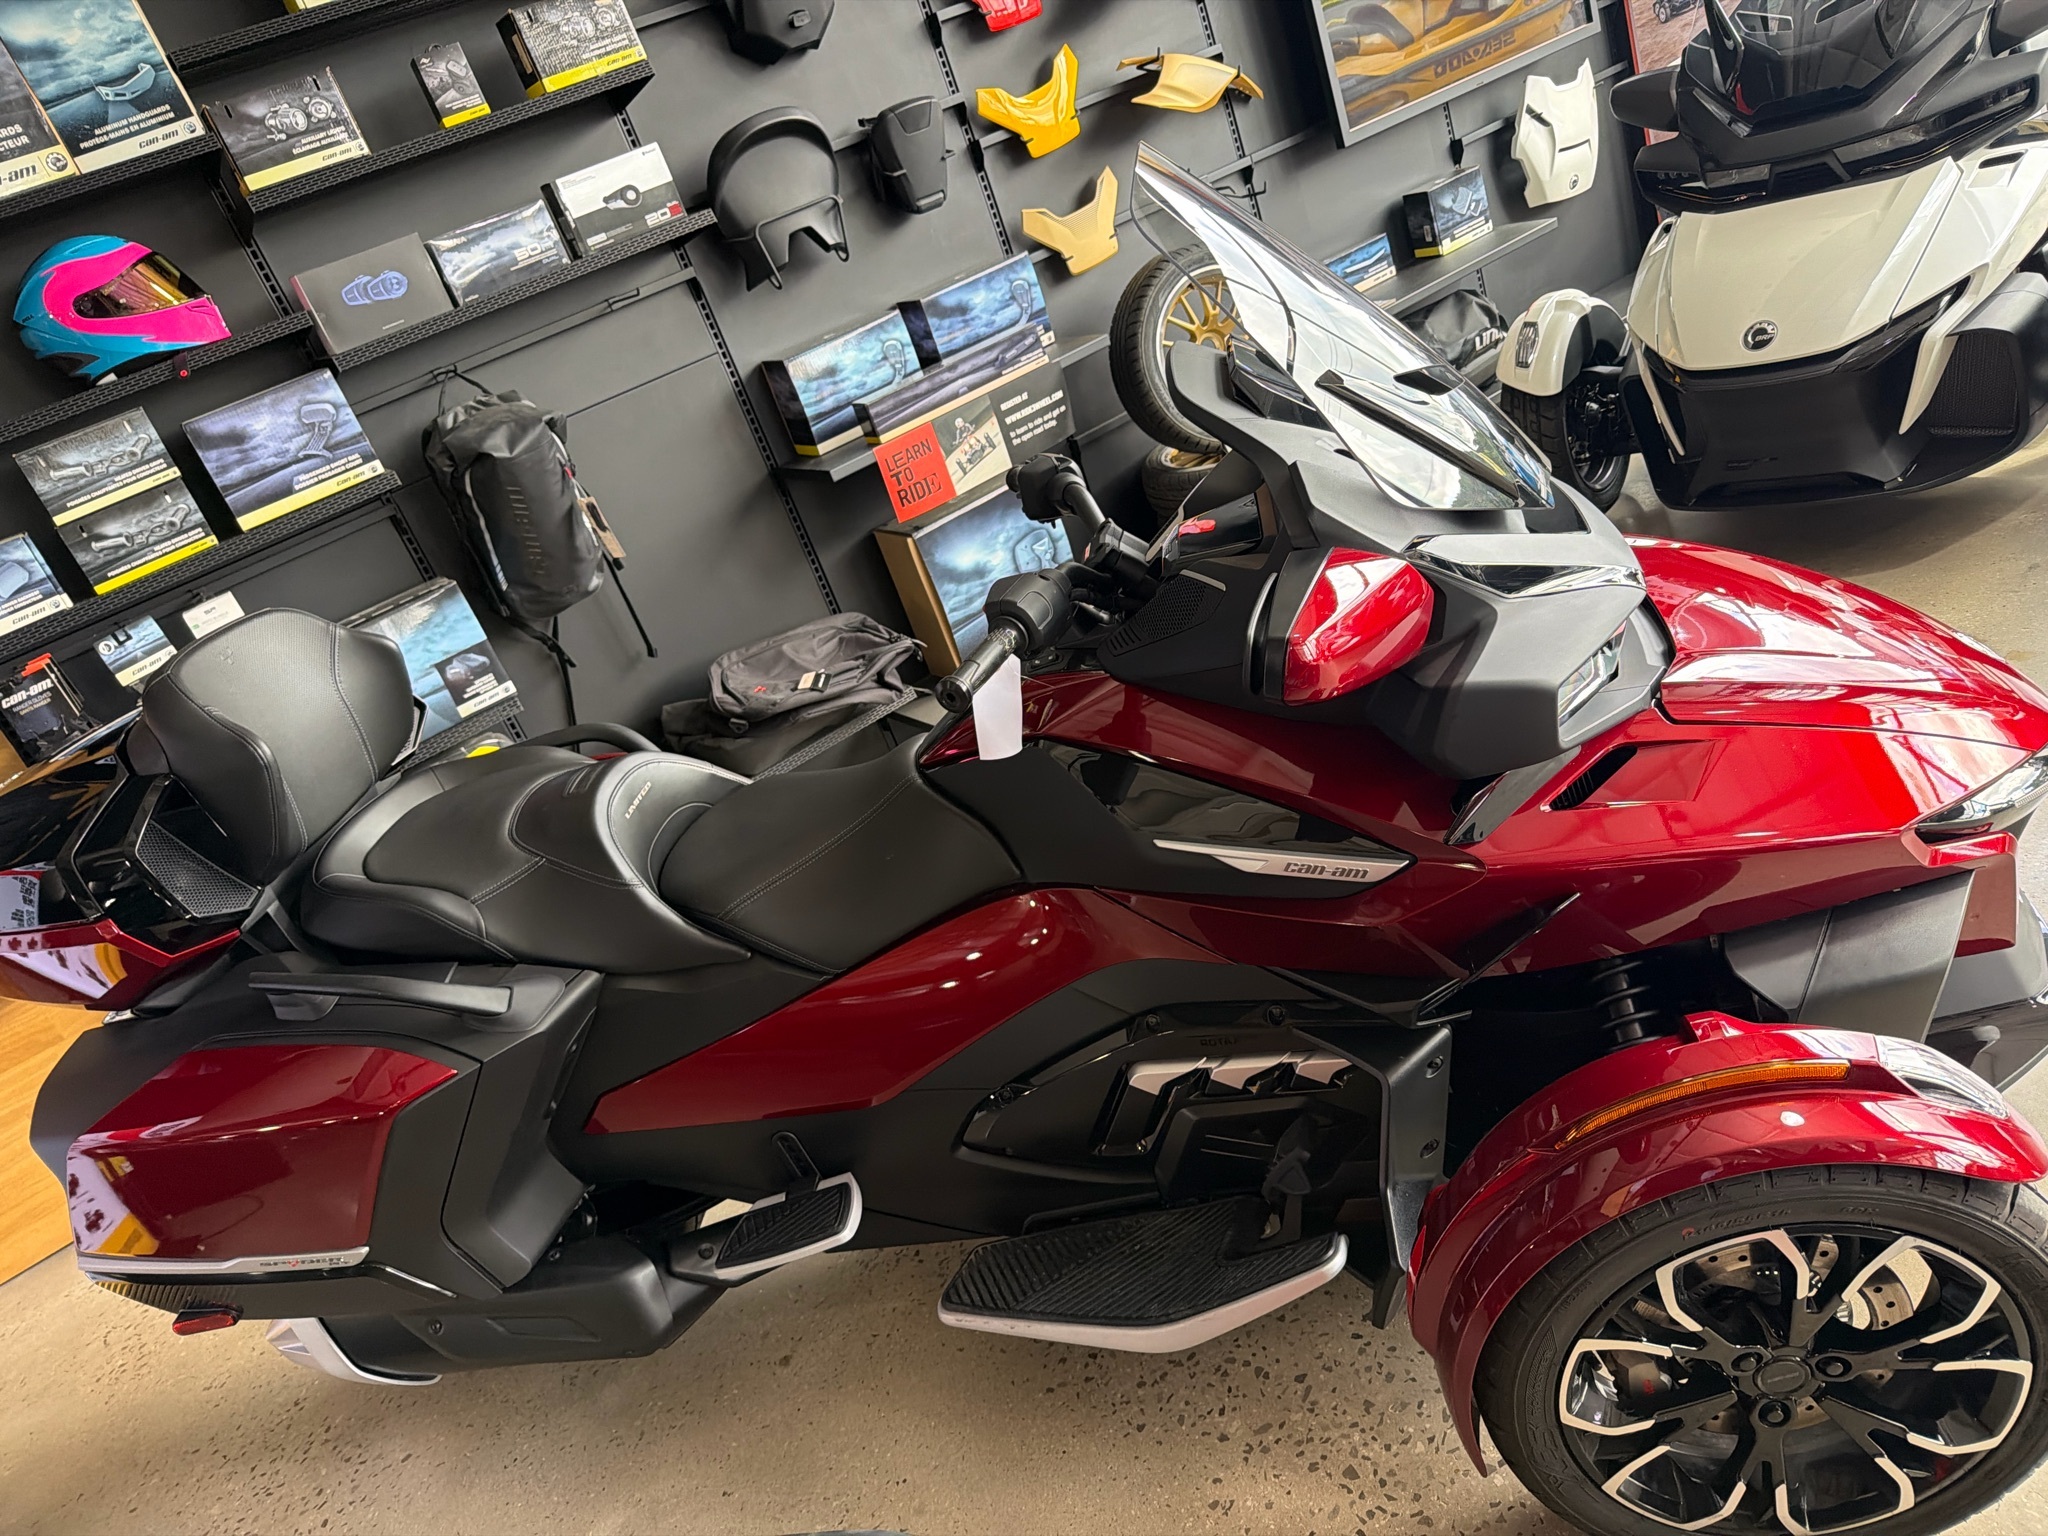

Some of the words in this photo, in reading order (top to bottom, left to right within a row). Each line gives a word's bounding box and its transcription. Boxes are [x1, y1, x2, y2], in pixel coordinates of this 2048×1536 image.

[94, 118, 128, 134] ALUMINUM
[128, 104, 171, 124] HANDGUARDS
[140, 111, 175, 129] ALUMINIUM
[139, 129, 179, 149] can-am
[1755, 333, 1775, 342] BRP
[885, 438, 932, 472] LEARN
[890, 467, 914, 487] TO
[897, 472, 942, 507] RIDE
[1, 678, 54, 709] can-am
[624, 781, 652, 819] LIMITED
[1283, 861, 1370, 880] can-am
